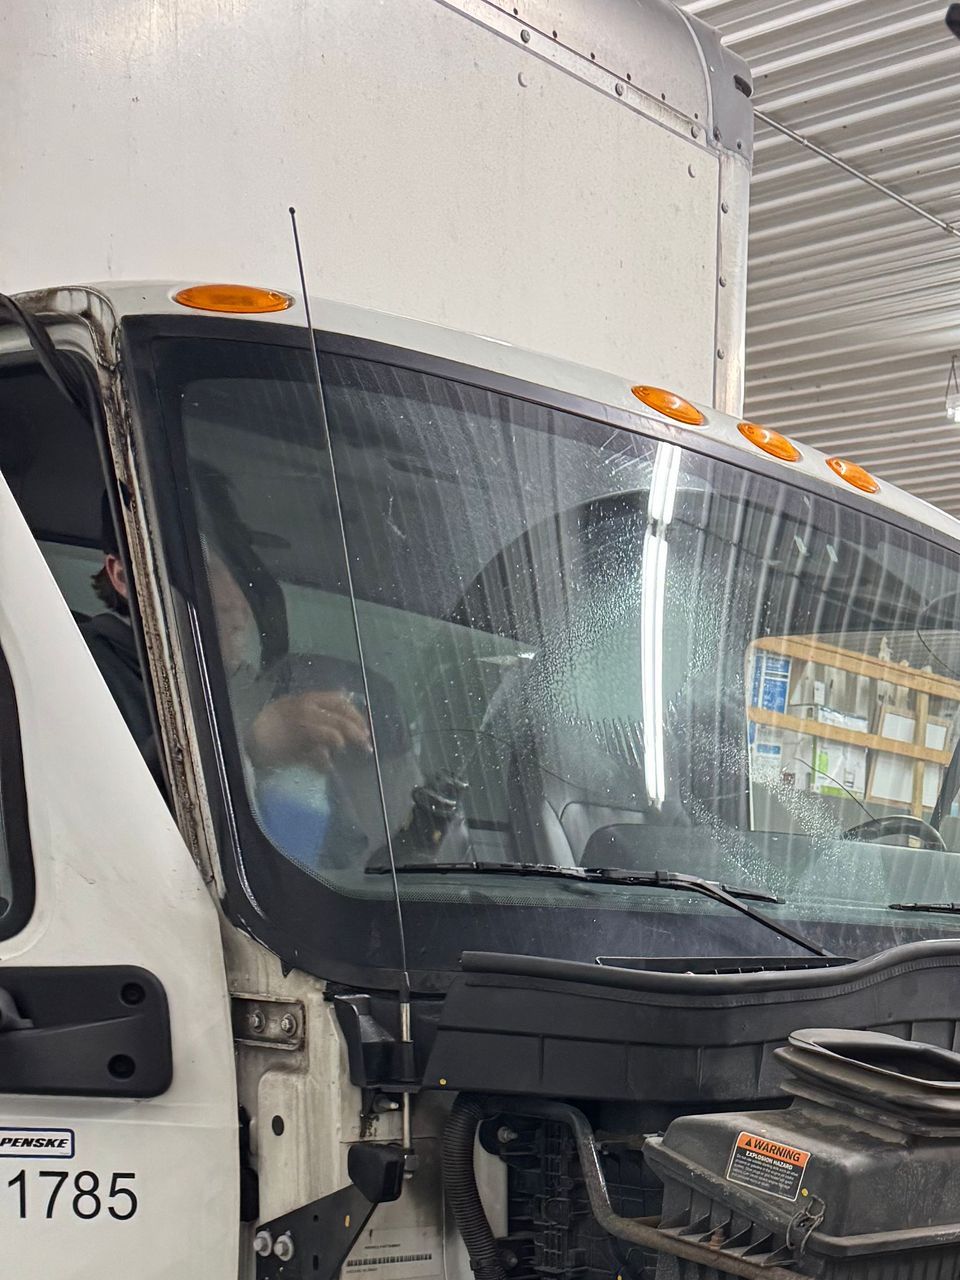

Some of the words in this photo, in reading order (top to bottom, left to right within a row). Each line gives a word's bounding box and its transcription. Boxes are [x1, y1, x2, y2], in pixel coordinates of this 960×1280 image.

[0, 1137, 69, 1149] PENSKE
[753, 1140, 801, 1162] WARNING
[746, 1151, 773, 1165] EXPLOSION
[773, 1160, 794, 1170] HAZARD
[8, 1169, 138, 1221] 1785
